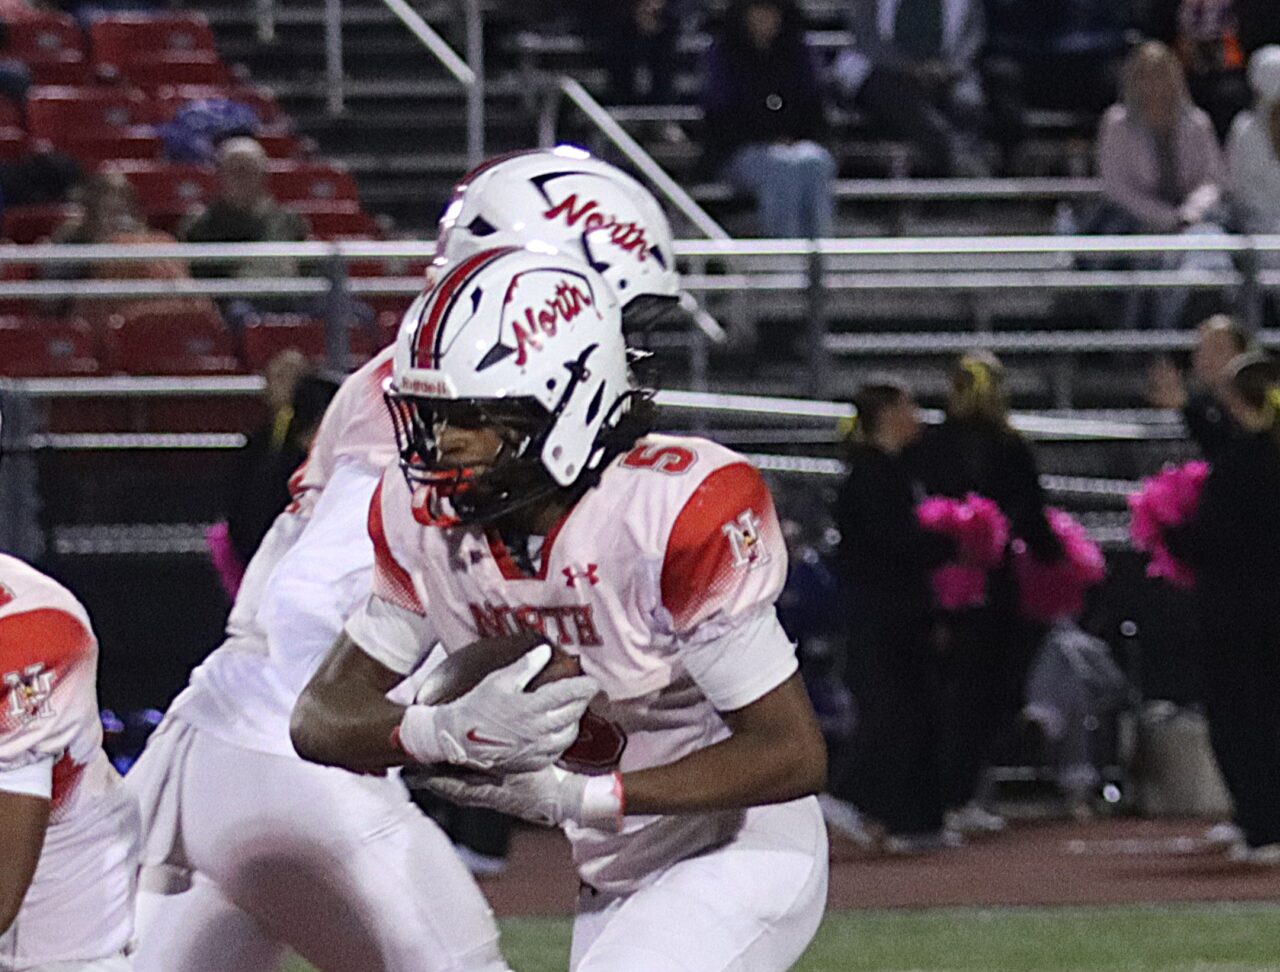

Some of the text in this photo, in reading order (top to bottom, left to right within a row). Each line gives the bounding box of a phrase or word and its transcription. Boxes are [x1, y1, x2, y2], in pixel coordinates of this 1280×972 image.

[543, 193, 648, 263] North
[511, 279, 593, 367] North
[618, 443, 699, 476] 5
